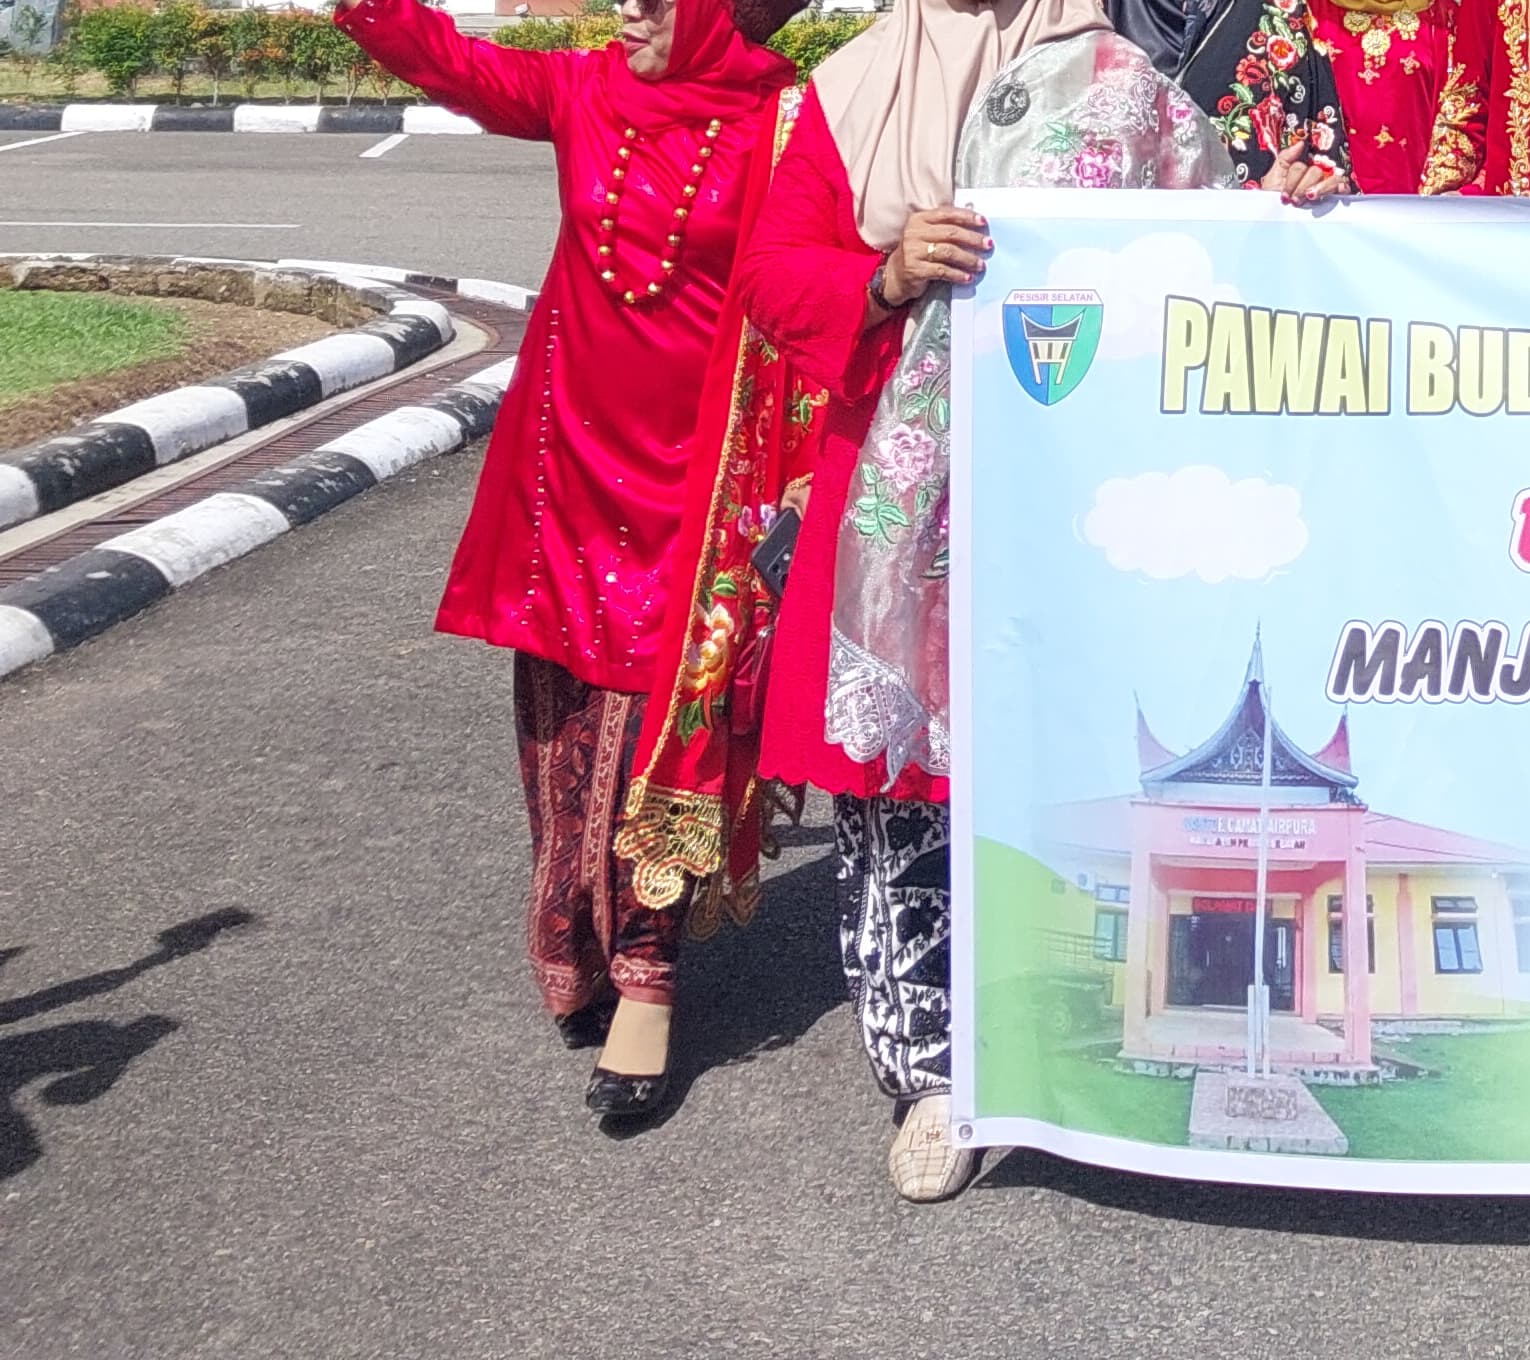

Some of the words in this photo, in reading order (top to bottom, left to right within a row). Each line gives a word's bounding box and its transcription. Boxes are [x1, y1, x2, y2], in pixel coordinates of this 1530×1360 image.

[1013, 292, 1049, 302] PESISIR
[1051, 292, 1094, 302] SELATAN
[1160, 294, 1391, 416] PAWAI
